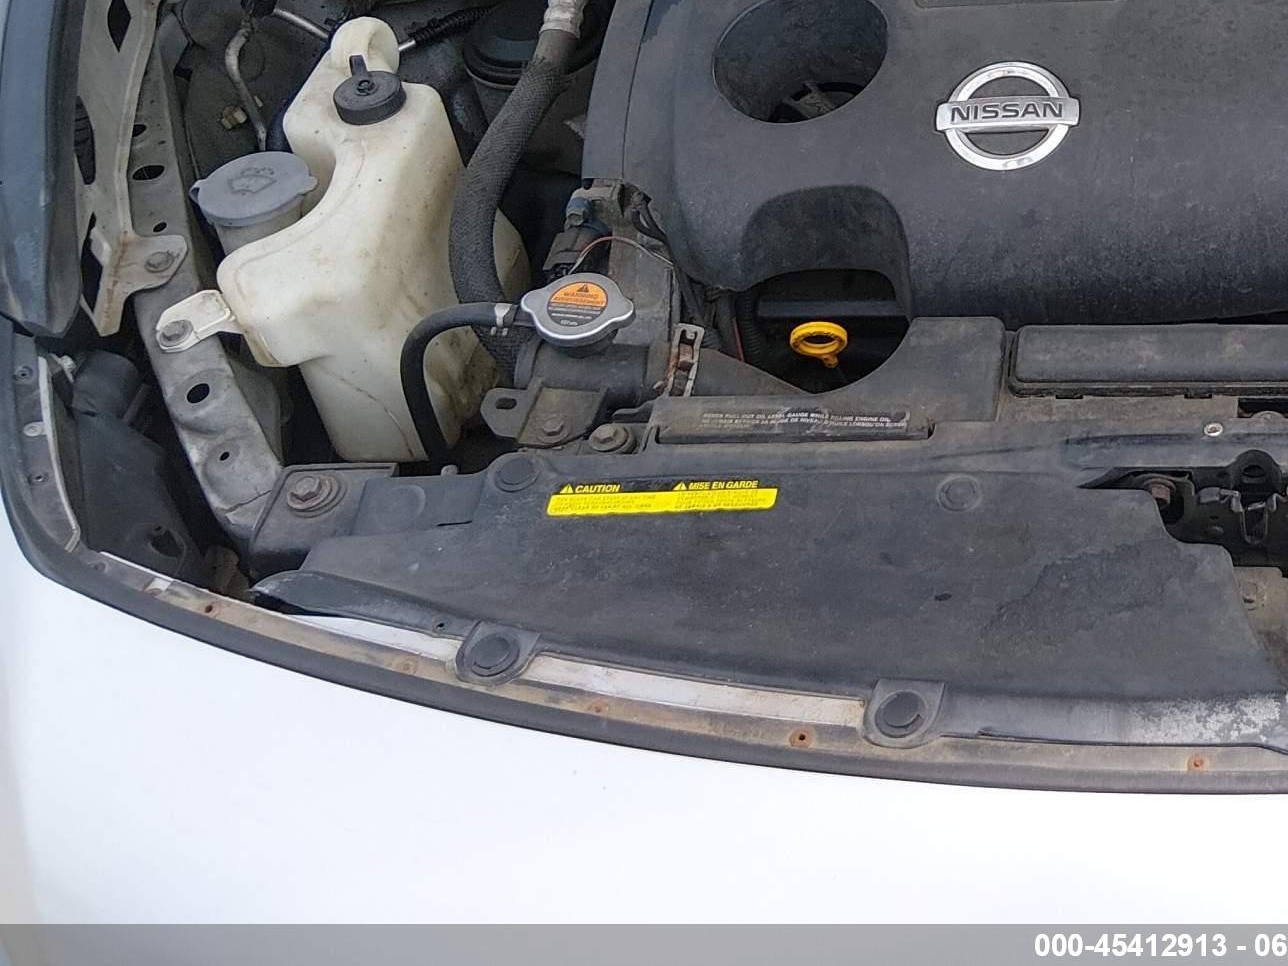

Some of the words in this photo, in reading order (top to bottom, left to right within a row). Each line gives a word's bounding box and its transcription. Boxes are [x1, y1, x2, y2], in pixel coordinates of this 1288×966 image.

[951, 103, 1063, 122] NISSAN
[575, 484, 620, 493] CAUTION
[688, 482, 710, 490] MISE
[711, 481, 725, 489] EN
[726, 480, 758, 489] GARDE
